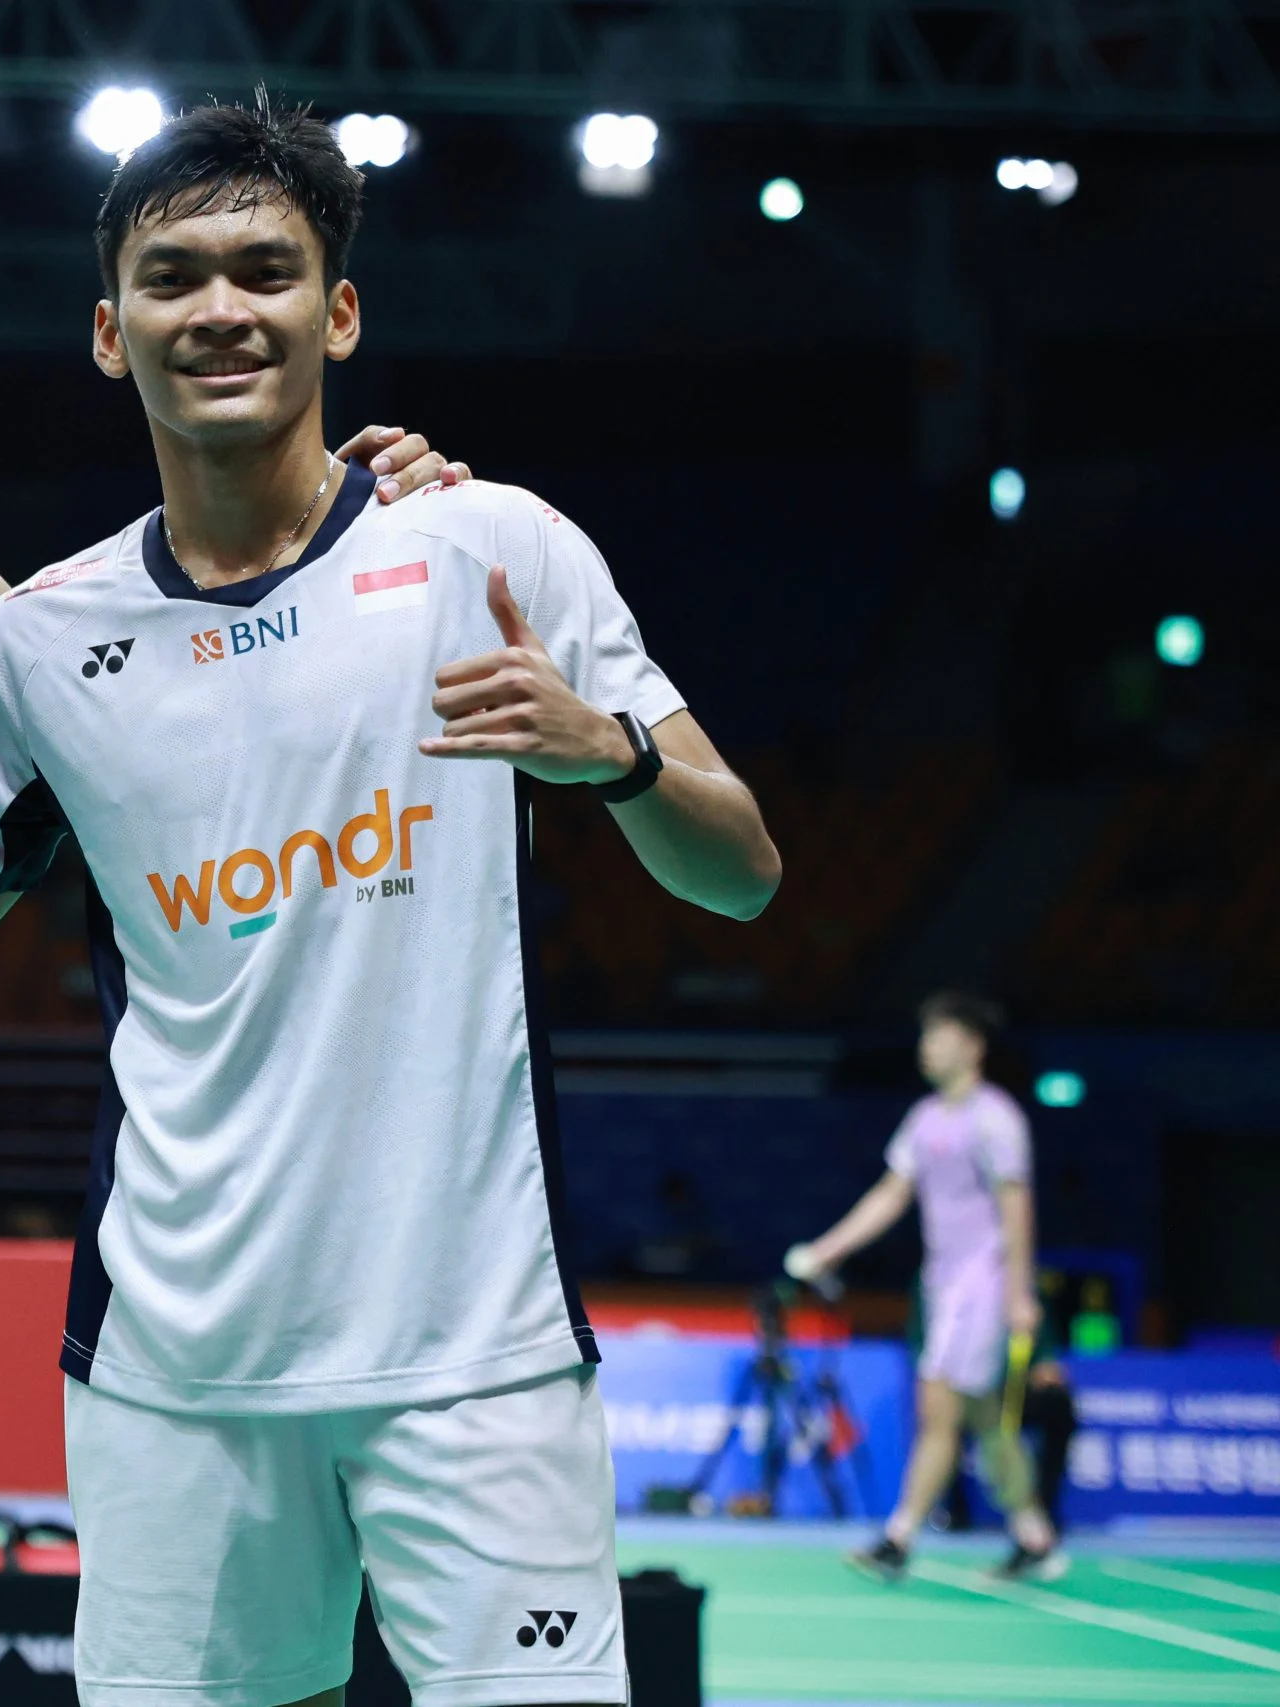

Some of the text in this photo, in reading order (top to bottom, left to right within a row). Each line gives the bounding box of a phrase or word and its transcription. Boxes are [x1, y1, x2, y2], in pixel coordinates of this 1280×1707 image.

[229, 606, 299, 656] BNI
[146, 788, 433, 934] wondr
[356, 876, 414, 904] by BNI
